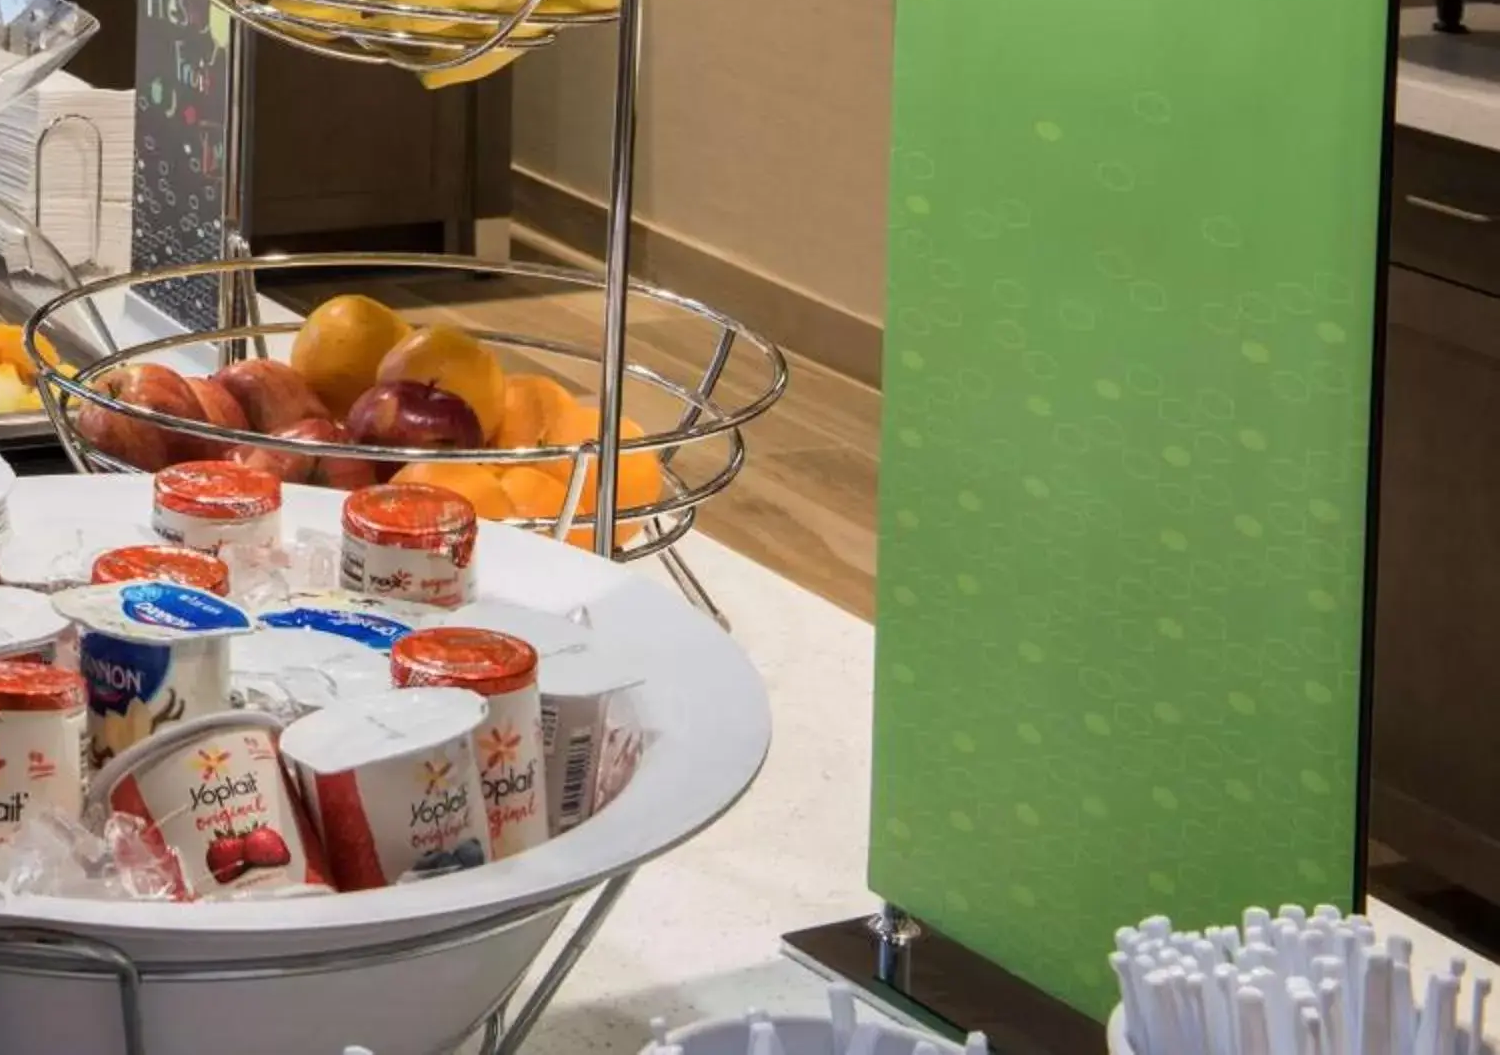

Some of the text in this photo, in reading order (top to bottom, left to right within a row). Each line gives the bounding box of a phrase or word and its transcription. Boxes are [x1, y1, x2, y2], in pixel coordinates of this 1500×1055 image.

[189, 772, 258, 811] Yoplait
[410, 783, 469, 827] Yoplait
[481, 763, 536, 805] oplait
